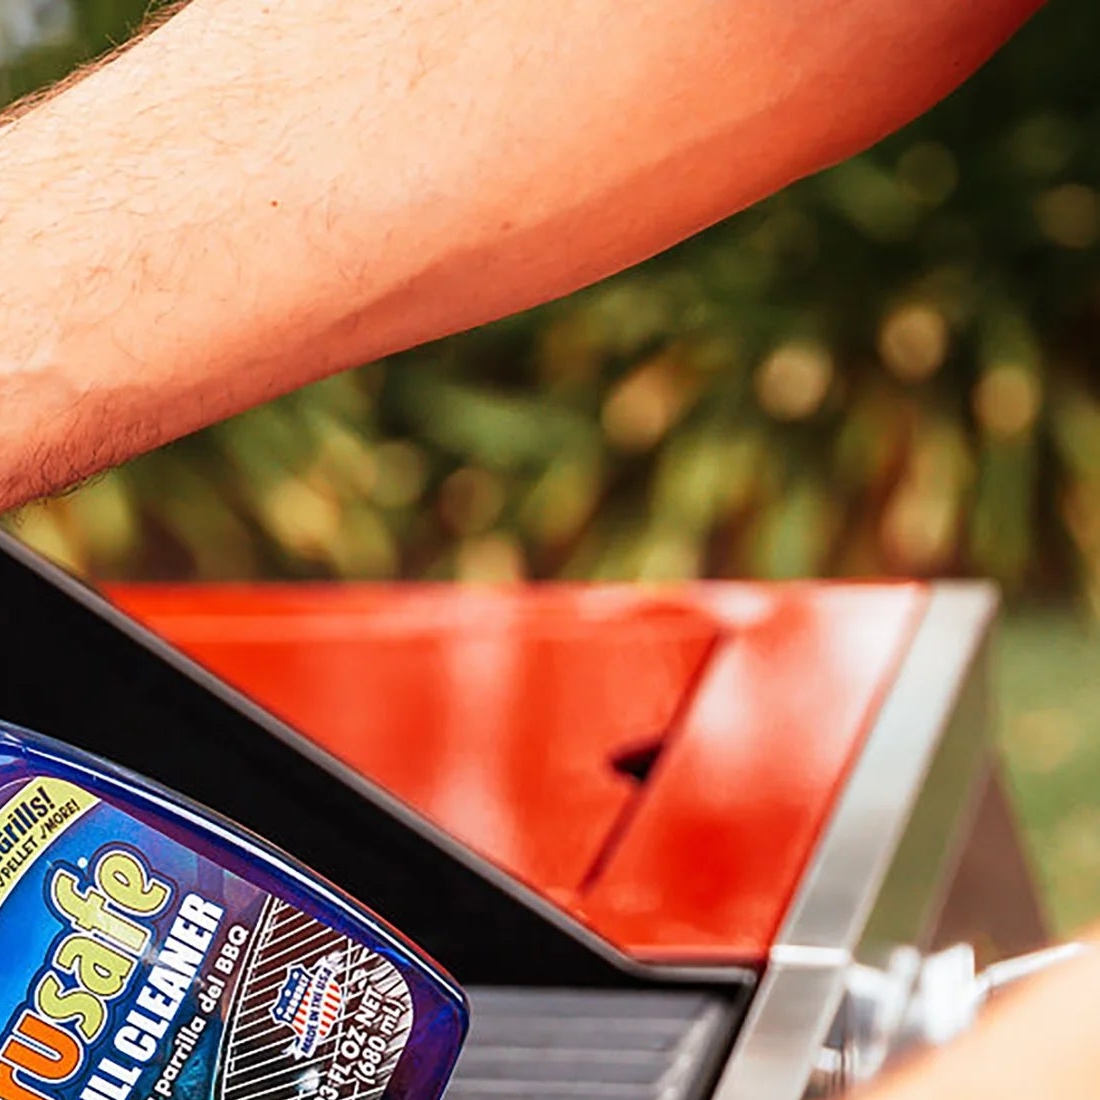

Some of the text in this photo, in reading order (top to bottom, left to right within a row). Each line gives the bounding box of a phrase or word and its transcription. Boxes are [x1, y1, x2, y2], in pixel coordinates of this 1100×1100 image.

[113, 893, 225, 1061] CLEANER
[155, 1017, 207, 1095] parrilla
[201, 973, 225, 1012] del
[215, 926, 249, 974] BBQ
[300, 1027, 317, 1053] MADE
[311, 990, 321, 1011] THE
[316, 967, 332, 992] USA
[328, 1063, 352, 1086] FL
[341, 1026, 367, 1059] OZ
[355, 985, 383, 1027] NET
[353, 1001, 405, 1084] (680 mL)
